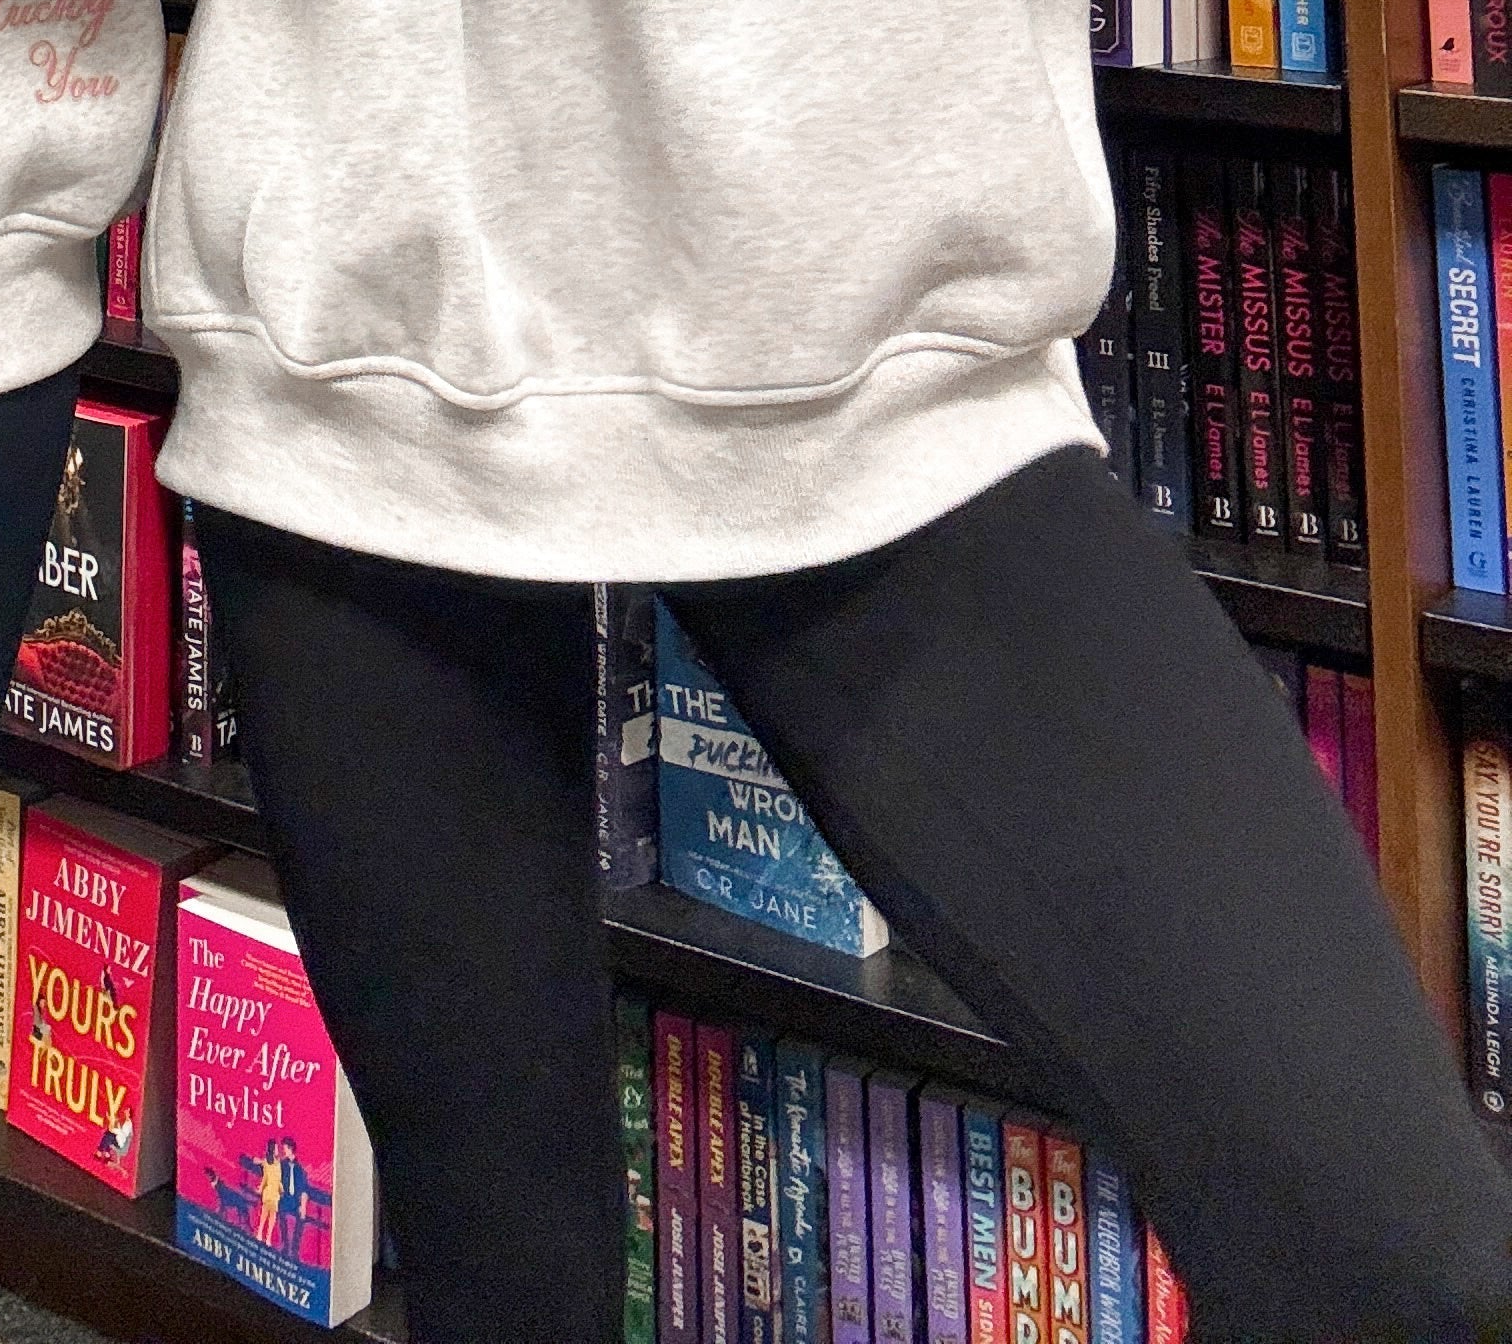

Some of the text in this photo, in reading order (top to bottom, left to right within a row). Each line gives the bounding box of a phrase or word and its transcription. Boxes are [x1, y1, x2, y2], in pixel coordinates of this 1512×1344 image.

[29, 40, 119, 103] You
[1447, 267, 1481, 369] SECRET
[184, 577, 203, 711] TATE JAMES
[38, 702, 114, 752] JAMES
[54, 858, 128, 915] ABBY
[26, 889, 150, 978] JIMENEZ
[189, 938, 225, 969] The
[28, 954, 137, 1058] YOURS
[188, 983, 272, 1036] Happy
[28, 1036, 128, 1129] TRULY
[188, 1029, 322, 1091] Ever After
[190, 1074, 286, 1129] Playlist
[193, 1228, 311, 1309] ABBY JIMENEZ
